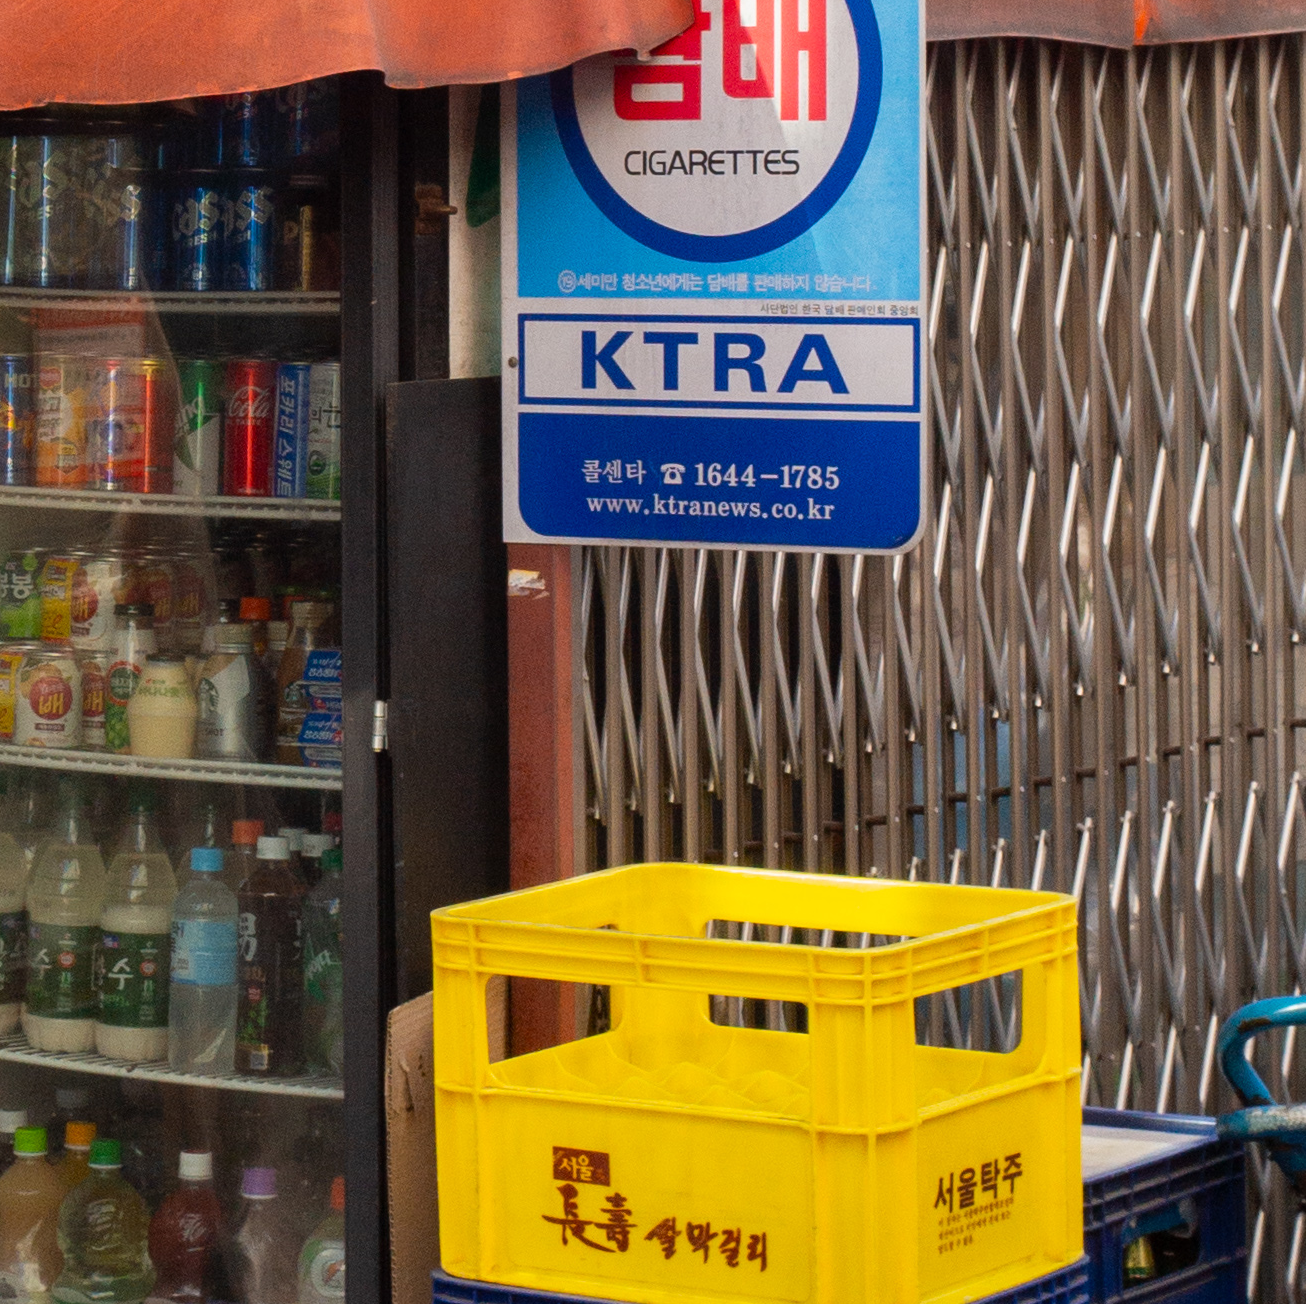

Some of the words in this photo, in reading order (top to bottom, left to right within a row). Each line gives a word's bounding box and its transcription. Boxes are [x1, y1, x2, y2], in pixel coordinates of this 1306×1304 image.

[624, 150, 800, 176] CIGARETTES
[622, 272, 704, 293] 청소년에게는
[708, 273, 749, 293] 담배를
[754, 273, 808, 292] 판매하지
[581, 330, 850, 394] KTRA
[581, 459, 647, 485] 콜센타
[695, 464, 840, 490] 1644-1785
[586, 494, 835, 520] www.ktranews.co.kr
[559, 1154, 594, 1181] 서울
[933, 1151, 1024, 1214] 서울탁주
